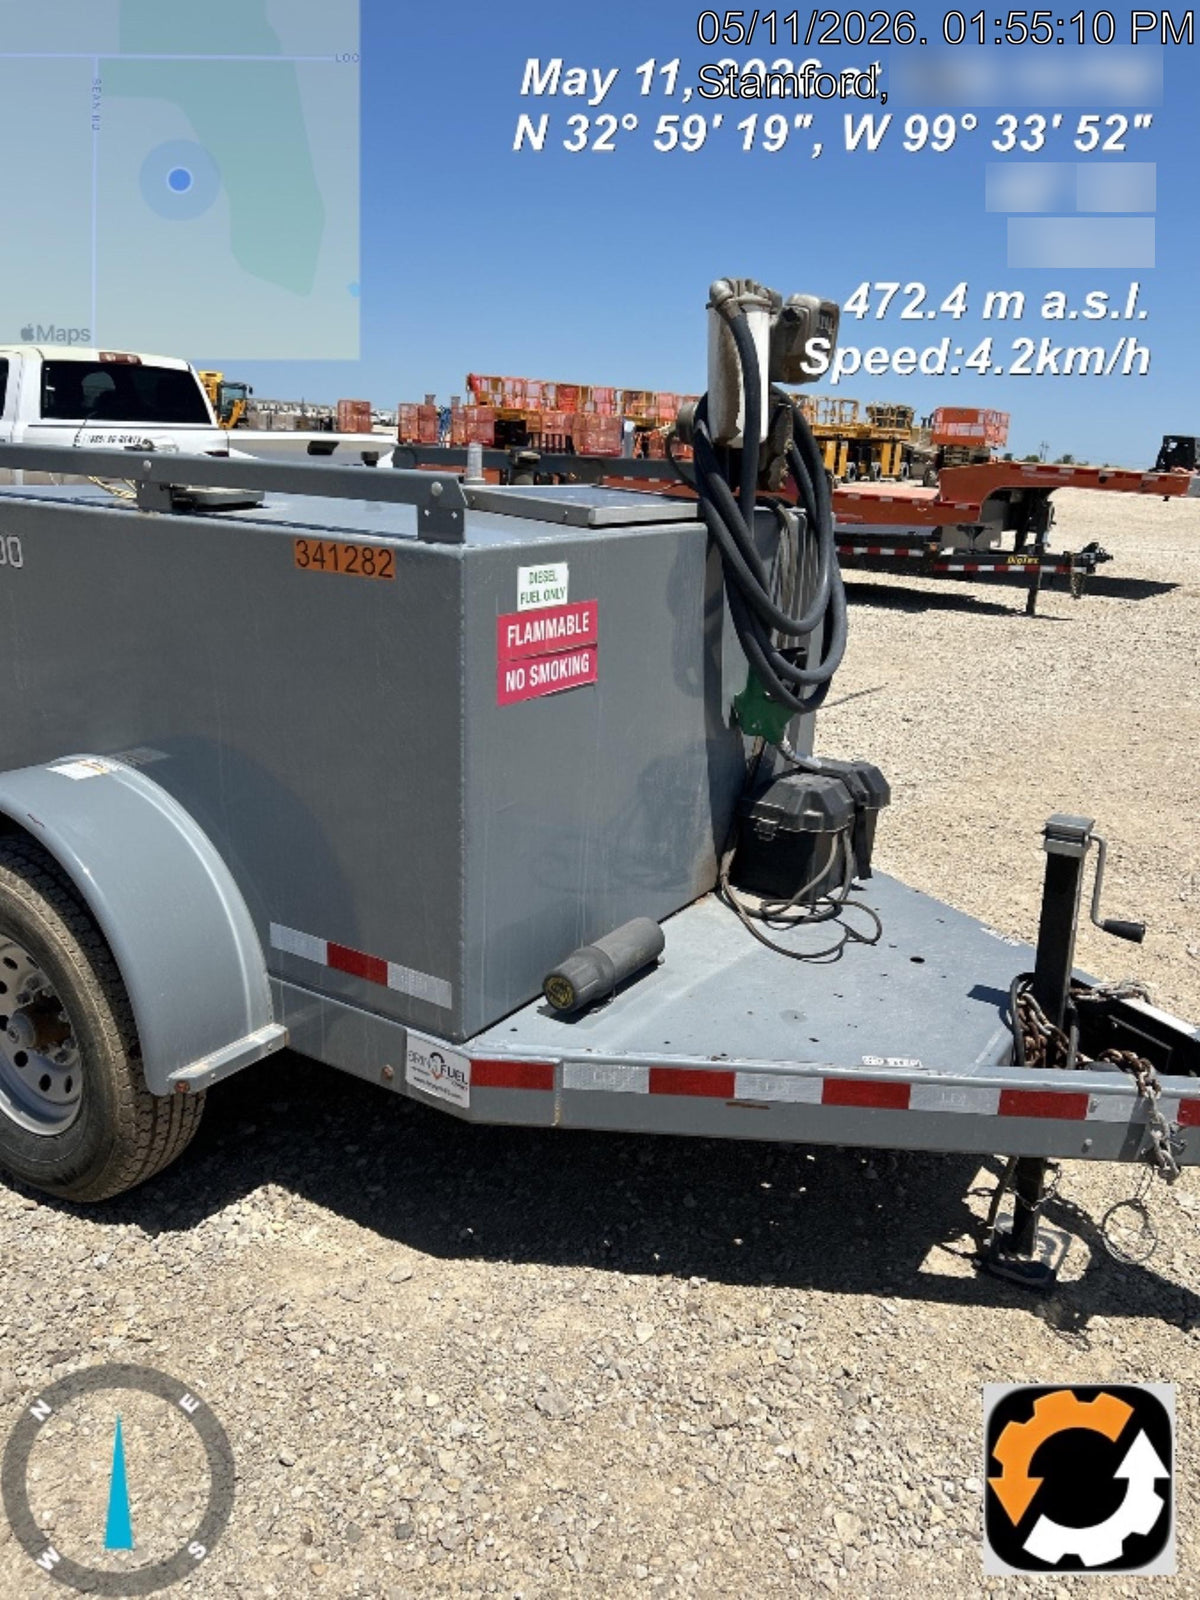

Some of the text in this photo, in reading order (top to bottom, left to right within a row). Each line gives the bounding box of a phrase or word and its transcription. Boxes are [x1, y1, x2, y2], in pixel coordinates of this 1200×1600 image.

[296, 539, 394, 579] 341282
[529, 569, 557, 584] DIESEL
[520, 586, 566, 605] FUEL ONLY
[507, 611, 590, 648] FLAMMABLE
[505, 653, 590, 693] NO SMOKING
